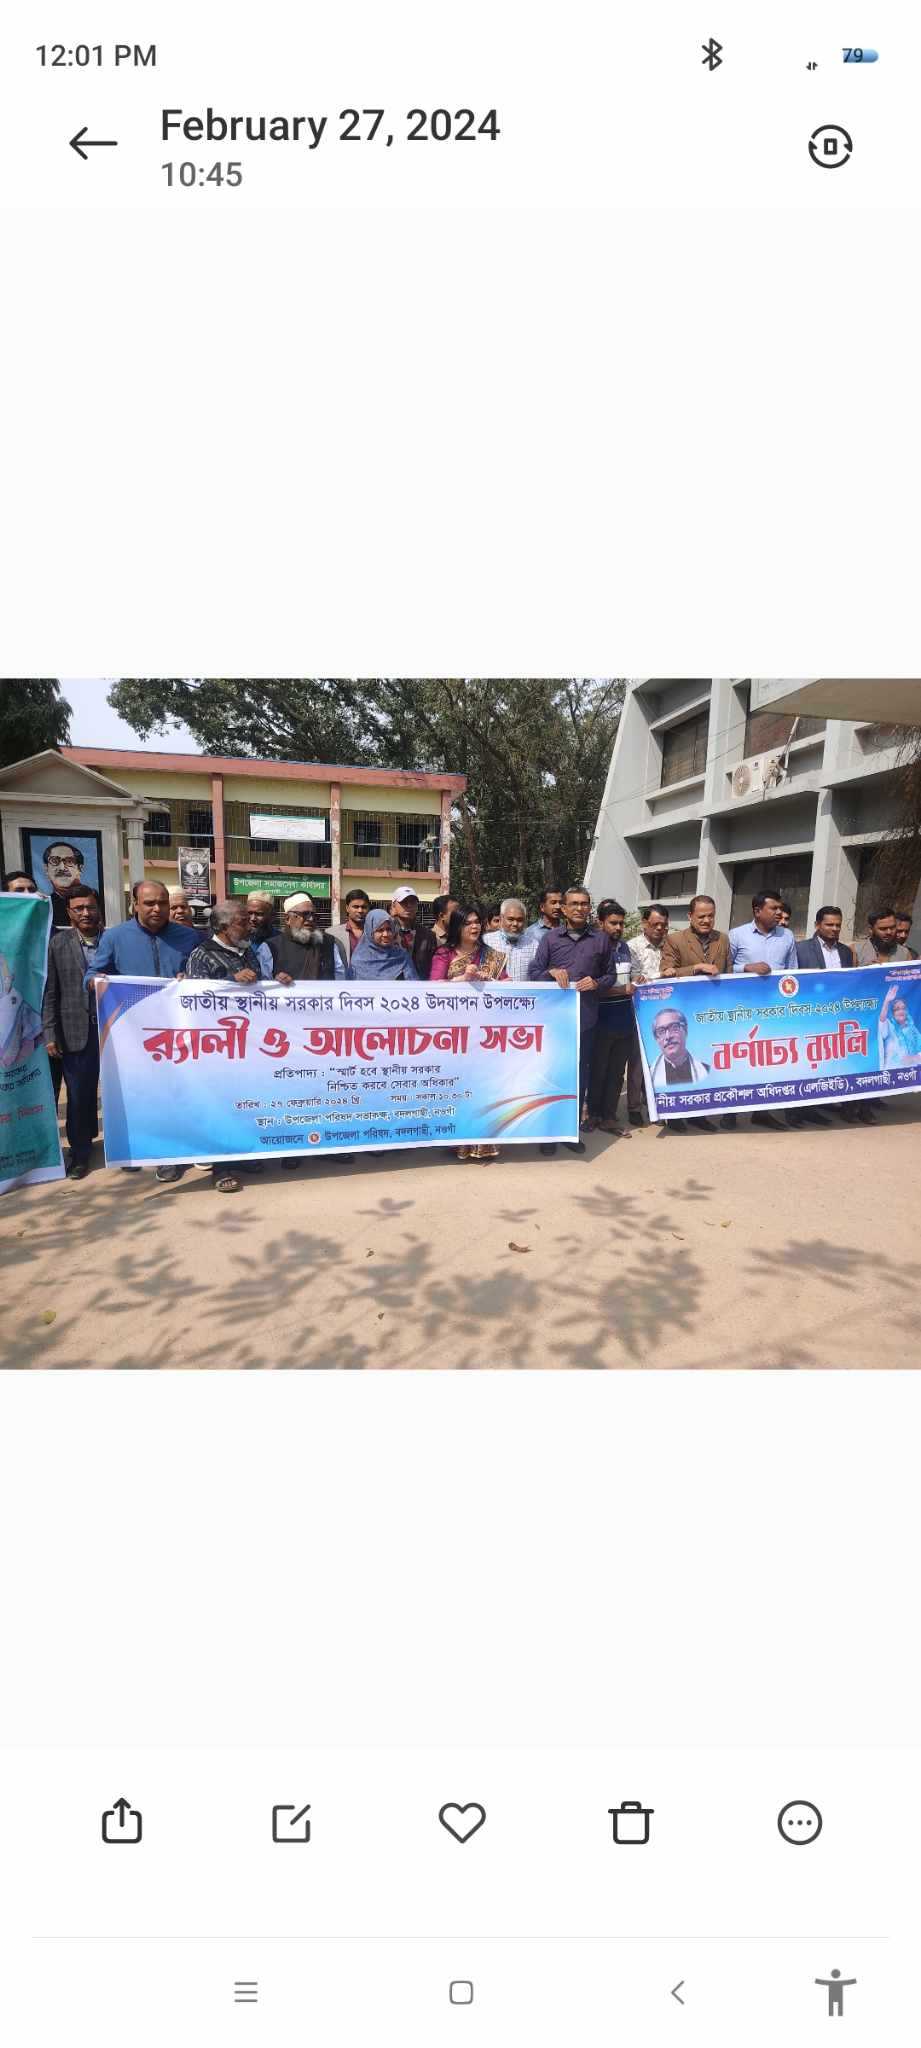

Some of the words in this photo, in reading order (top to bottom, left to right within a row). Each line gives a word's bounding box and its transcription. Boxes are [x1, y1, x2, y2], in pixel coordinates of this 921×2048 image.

[35, 44, 103, 67] 12:01
[114, 44, 157, 67] PM
[842, 47, 864, 63] 79
[161, 107, 328, 149] February
[338, 108, 394, 147] 27,
[406, 108, 501, 141] 2024
[161, 161, 243, 187] 10:45
[180, 990, 229, 1012] জাতীয়
[235, 989, 281, 1014] স্থানীয়
[284, 993, 334, 1012] সরকার
[339, 991, 374, 1012] দিবস
[381, 996, 420, 1012] ২০২৪
[755, 1004, 786, 1017] সরকার
[259, 1027, 291, 1058] ও
[303, 1025, 471, 1061] আলোচনা
[480, 1025, 545, 1053] সভা
[712, 1024, 799, 1070] বর্ণাঢ্য
[273, 1067, 318, 1079] প্রতিপাদ্য
[360, 1066, 377, 1076] হবে
[381, 1063, 408, 1077] স্থানীয়
[410, 1064, 441, 1075] সরকার
[327, 1080, 358, 1092] নিশ্চিত
[362, 1080, 387, 1090] করবে
[391, 1079, 418, 1089] সেবার
[679, 1092, 711, 1105] সরকার
[714, 1087, 754, 1102] প্রকৌশল
